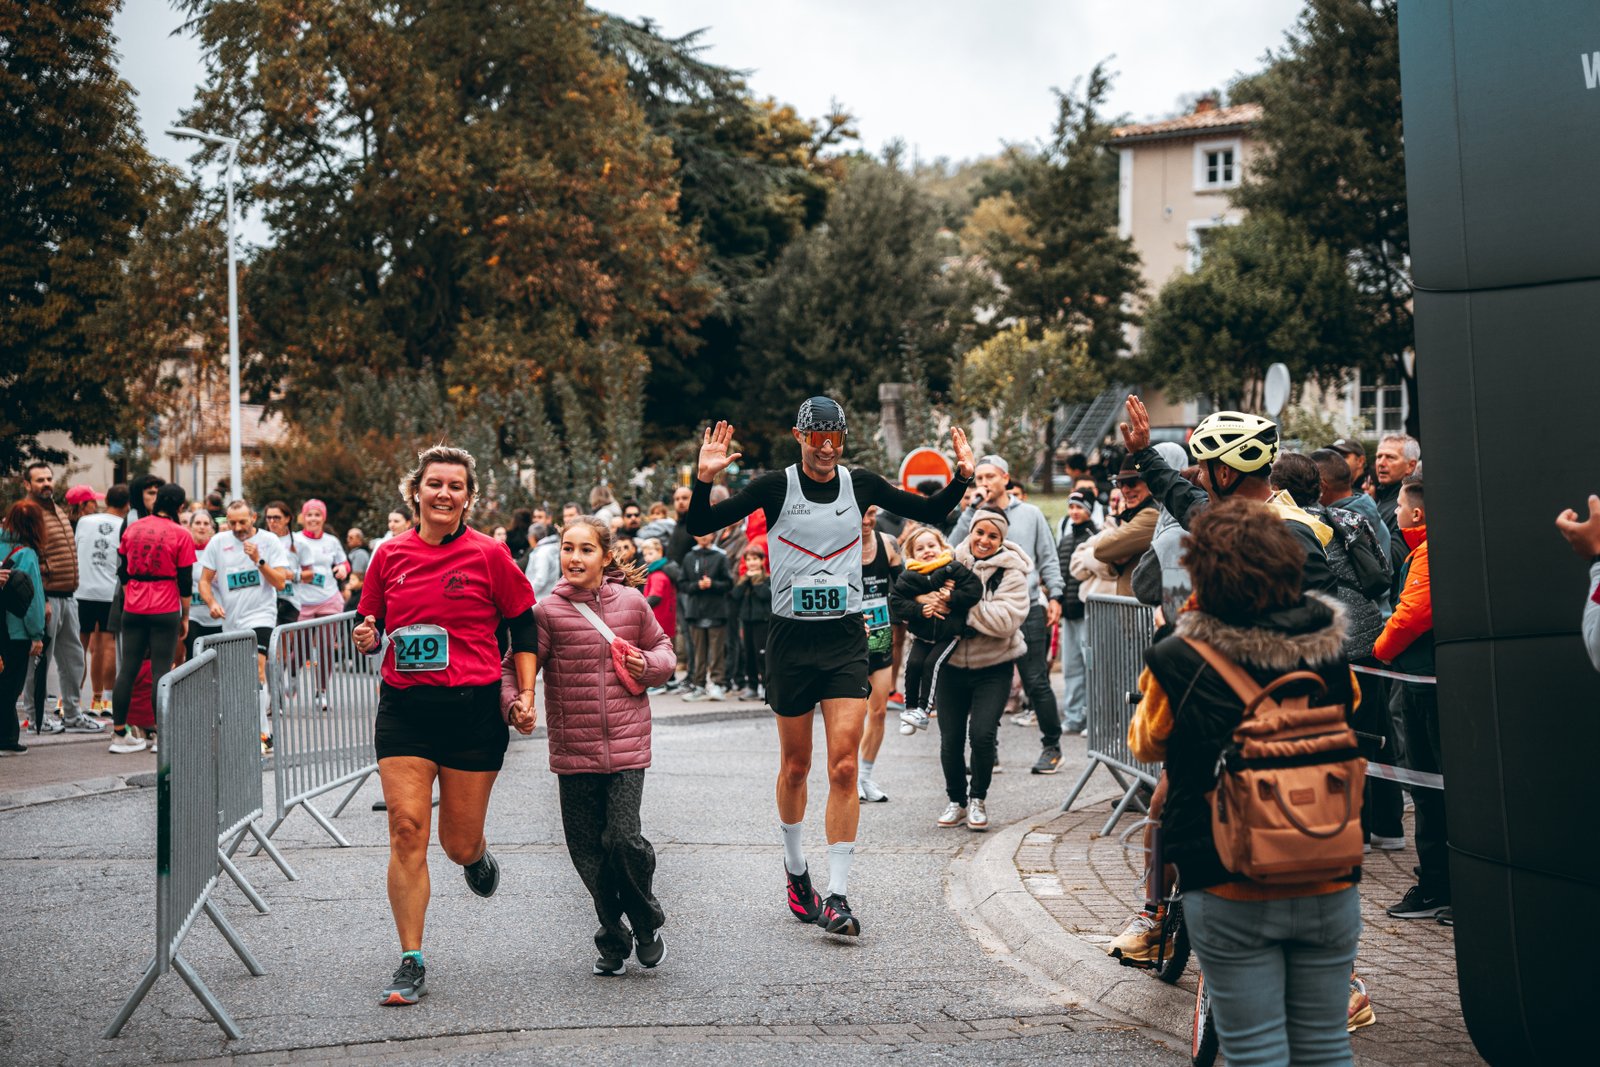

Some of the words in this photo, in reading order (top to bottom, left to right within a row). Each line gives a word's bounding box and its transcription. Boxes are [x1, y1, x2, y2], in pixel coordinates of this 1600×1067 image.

[231, 571, 256, 586] 166
[801, 588, 840, 610] 558
[398, 637, 439, 660] 249
